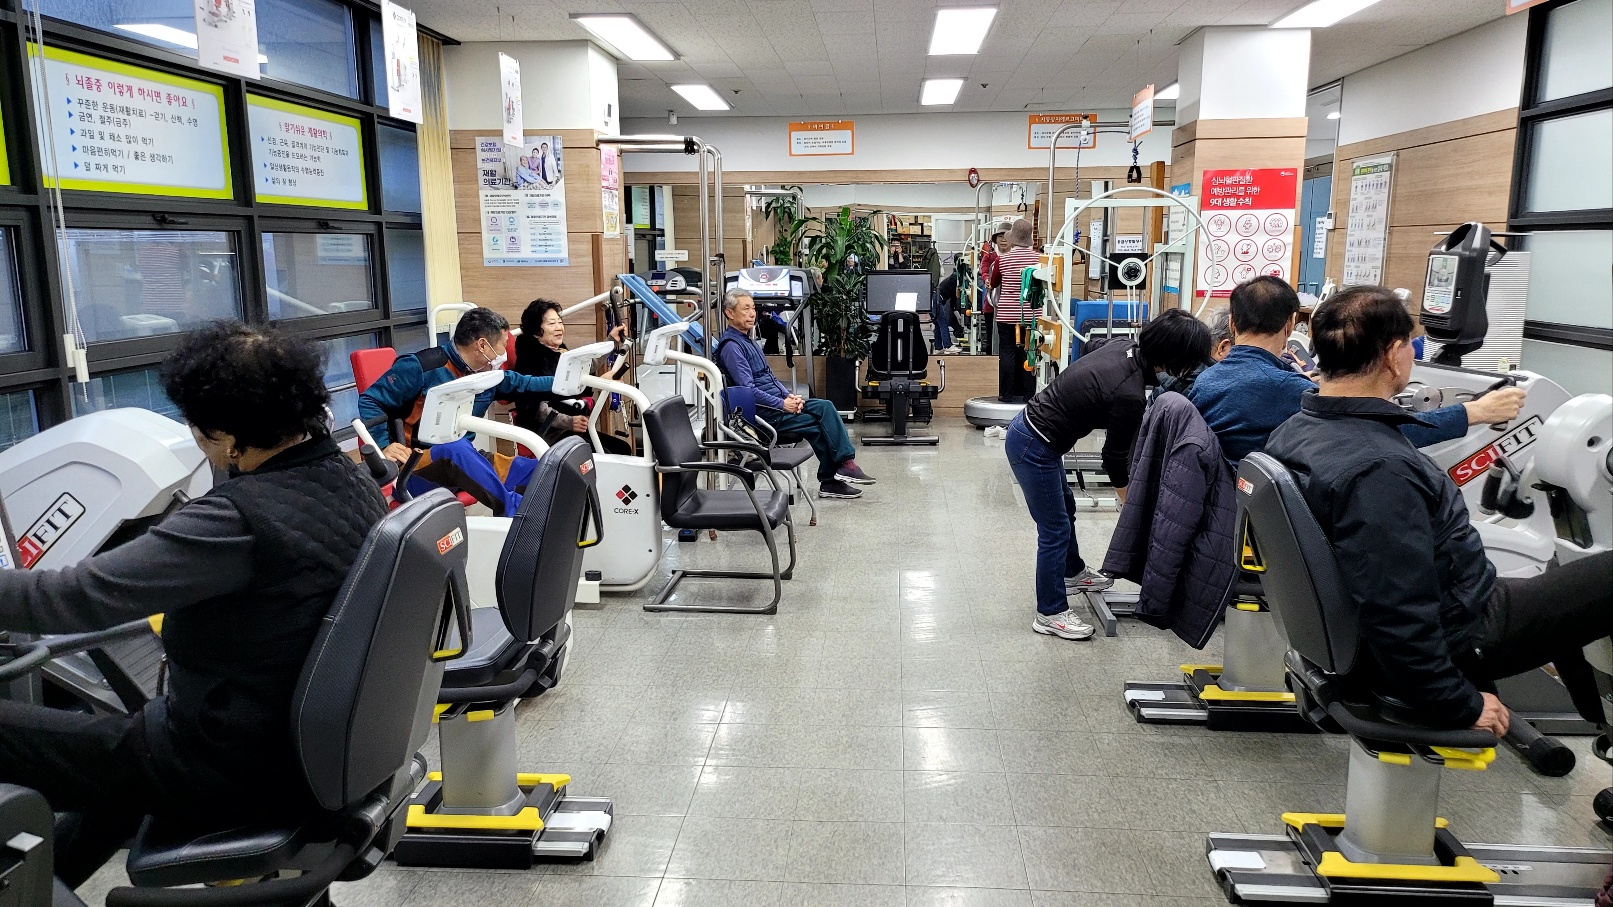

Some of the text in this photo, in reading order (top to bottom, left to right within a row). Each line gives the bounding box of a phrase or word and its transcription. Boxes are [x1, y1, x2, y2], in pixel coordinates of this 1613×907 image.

[76, 74, 102, 92] 뇌졸중
[108, 82, 134, 98] 이렇게
[138, 87, 162, 103] 하시면
[166, 93, 188, 107] 좋아요
[77, 98, 98, 110] 꾸준한
[102, 102, 146, 119] 운동(재활치료)
[187, 118, 198, 127] 수영
[99, 115, 131, 128] 절주(금주)
[284, 122, 305, 136] 알기쉬운
[80, 129, 154, 147] 과일 및 채소 많이 먹기
[134, 151, 146, 161] 좋은
[150, 153, 173, 164] 생각하기
[84, 162, 125, 174] 덜 짜게 먹기
[482, 169, 497, 177] 재활
[483, 178, 511, 186] 의료기관
[1211, 176, 1253, 186] 심뇌혈관질환
[1210, 186, 1260, 196] 예방관리를 위한
[1210, 197, 1252, 206] 9대 생활 수칙
[1456, 420, 1537, 480] SCIFIT
[440, 530, 461, 551] SCIFIT
